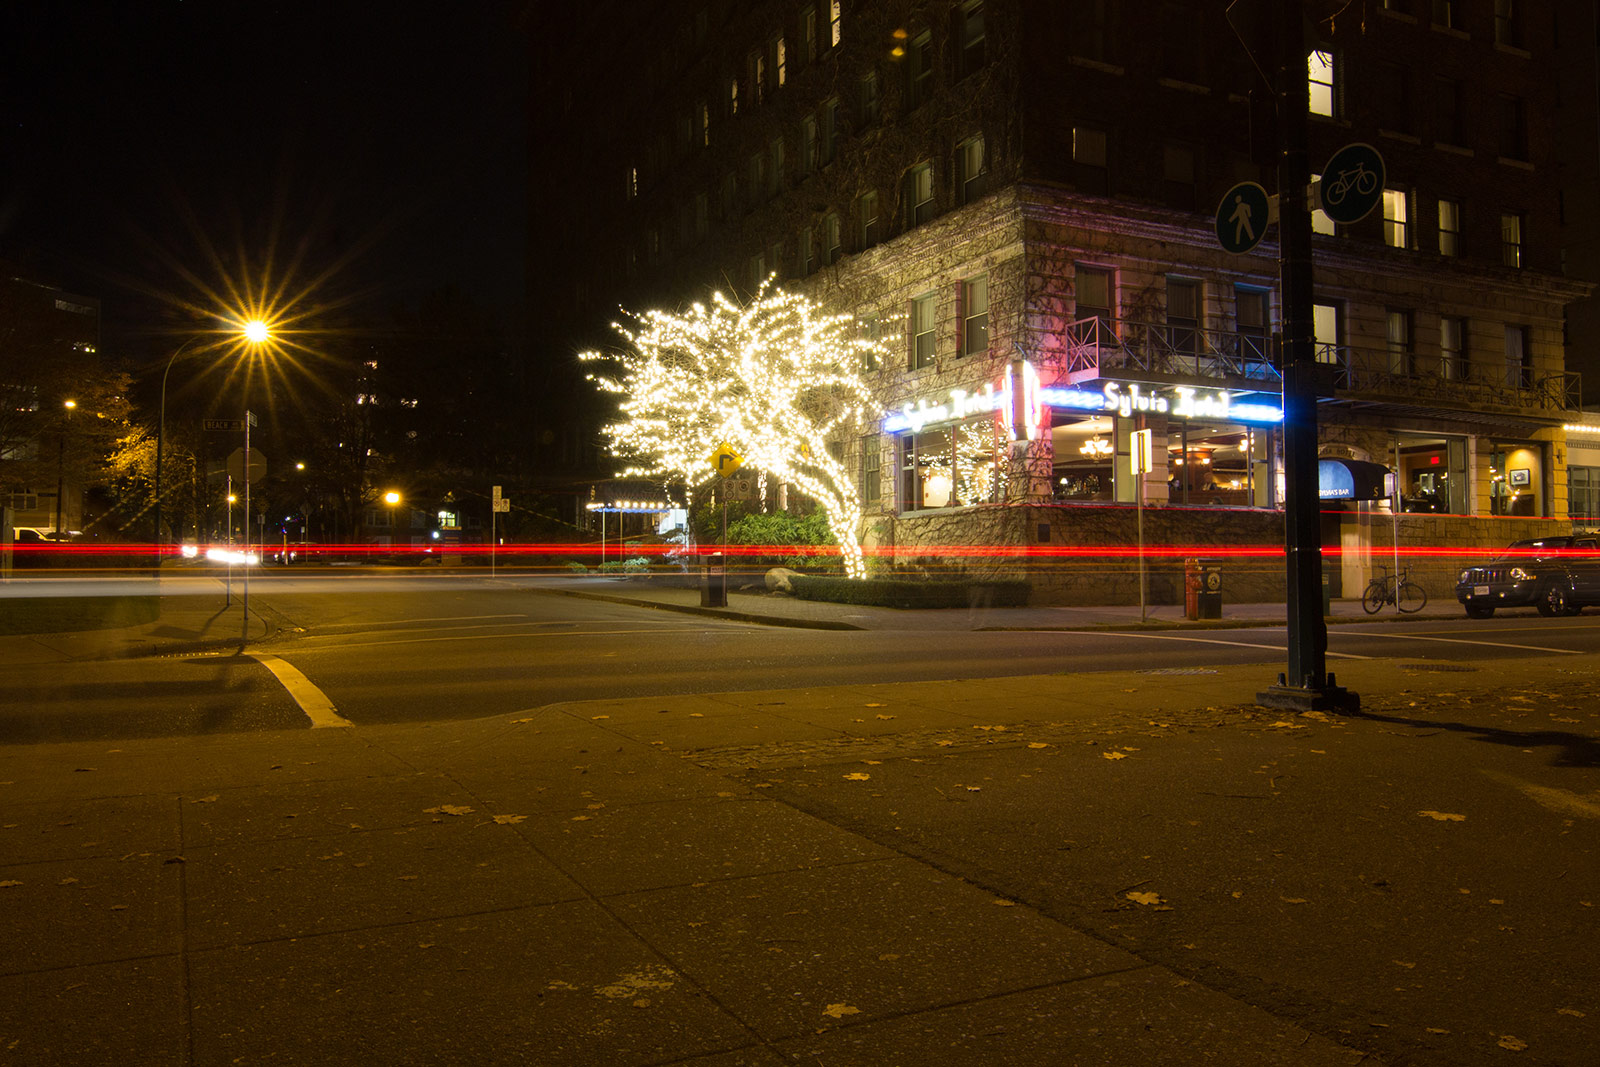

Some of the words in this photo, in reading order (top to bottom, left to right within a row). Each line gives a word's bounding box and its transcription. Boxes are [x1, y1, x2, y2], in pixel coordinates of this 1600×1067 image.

[1104, 382, 1167, 417] Sylvia
[1173, 387, 1229, 418] Hotel
[207, 421, 228, 429] BEACH
[1339, 488, 1350, 496] BAR
